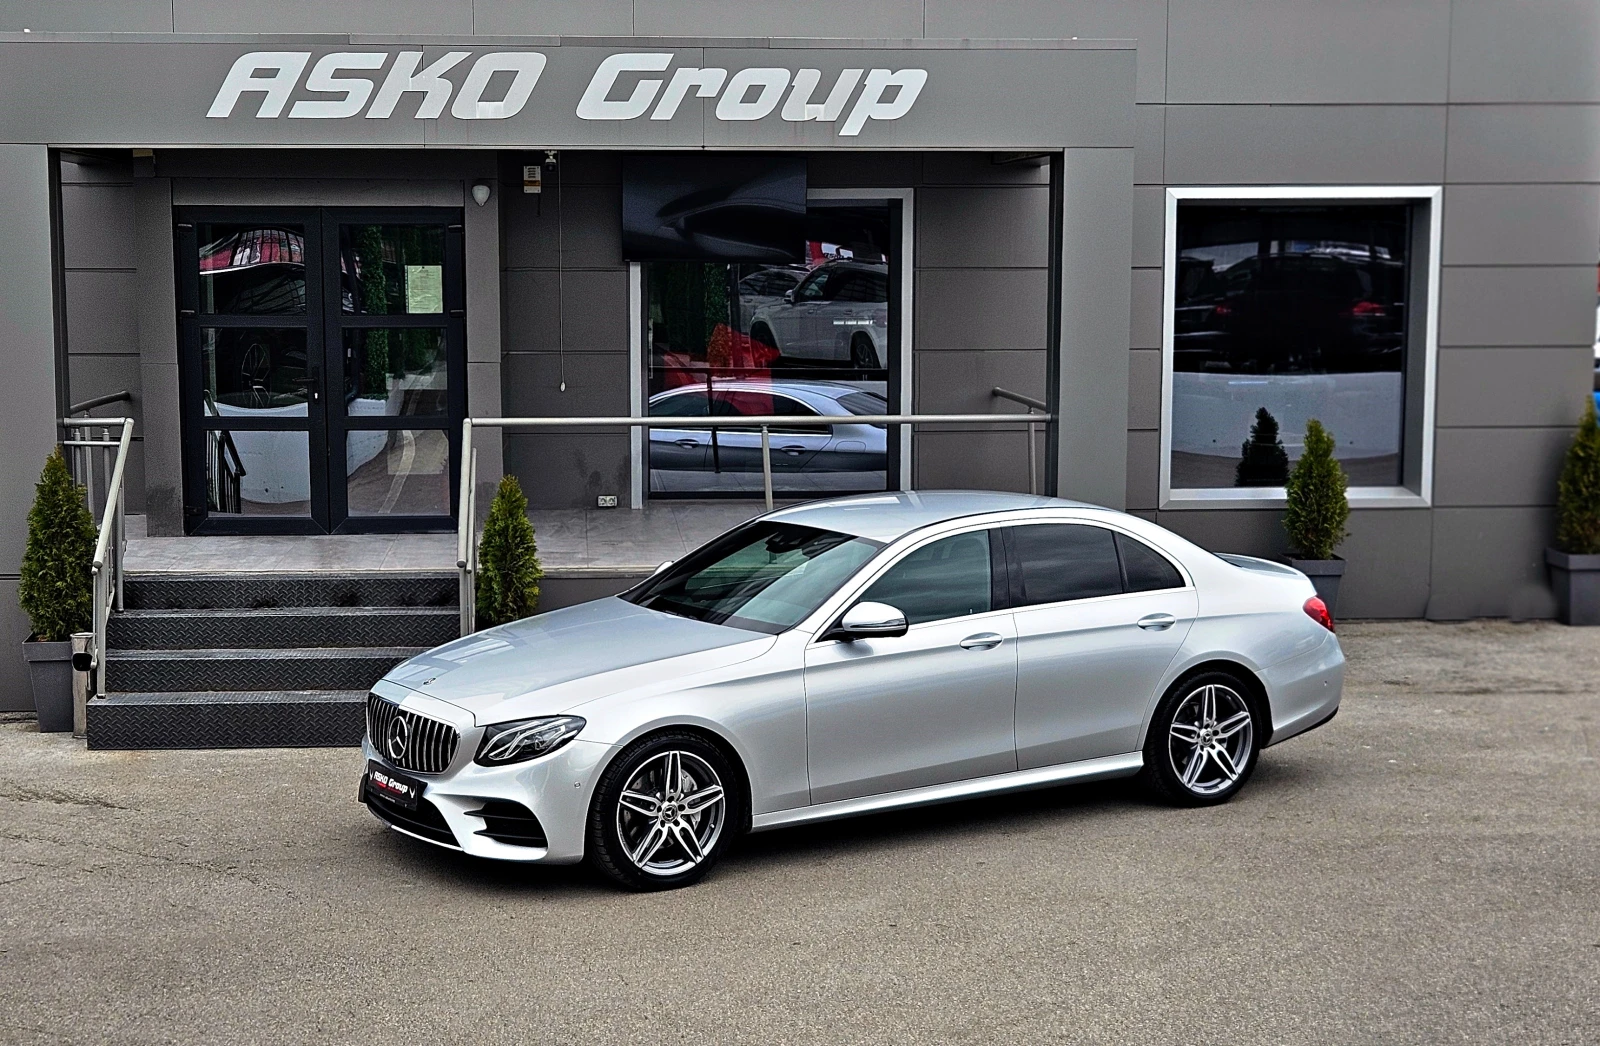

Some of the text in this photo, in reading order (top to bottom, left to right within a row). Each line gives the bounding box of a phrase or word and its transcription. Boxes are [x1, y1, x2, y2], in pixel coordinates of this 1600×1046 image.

[206, 51, 928, 136] ASKO Group
[388, 778, 408, 794] Group
